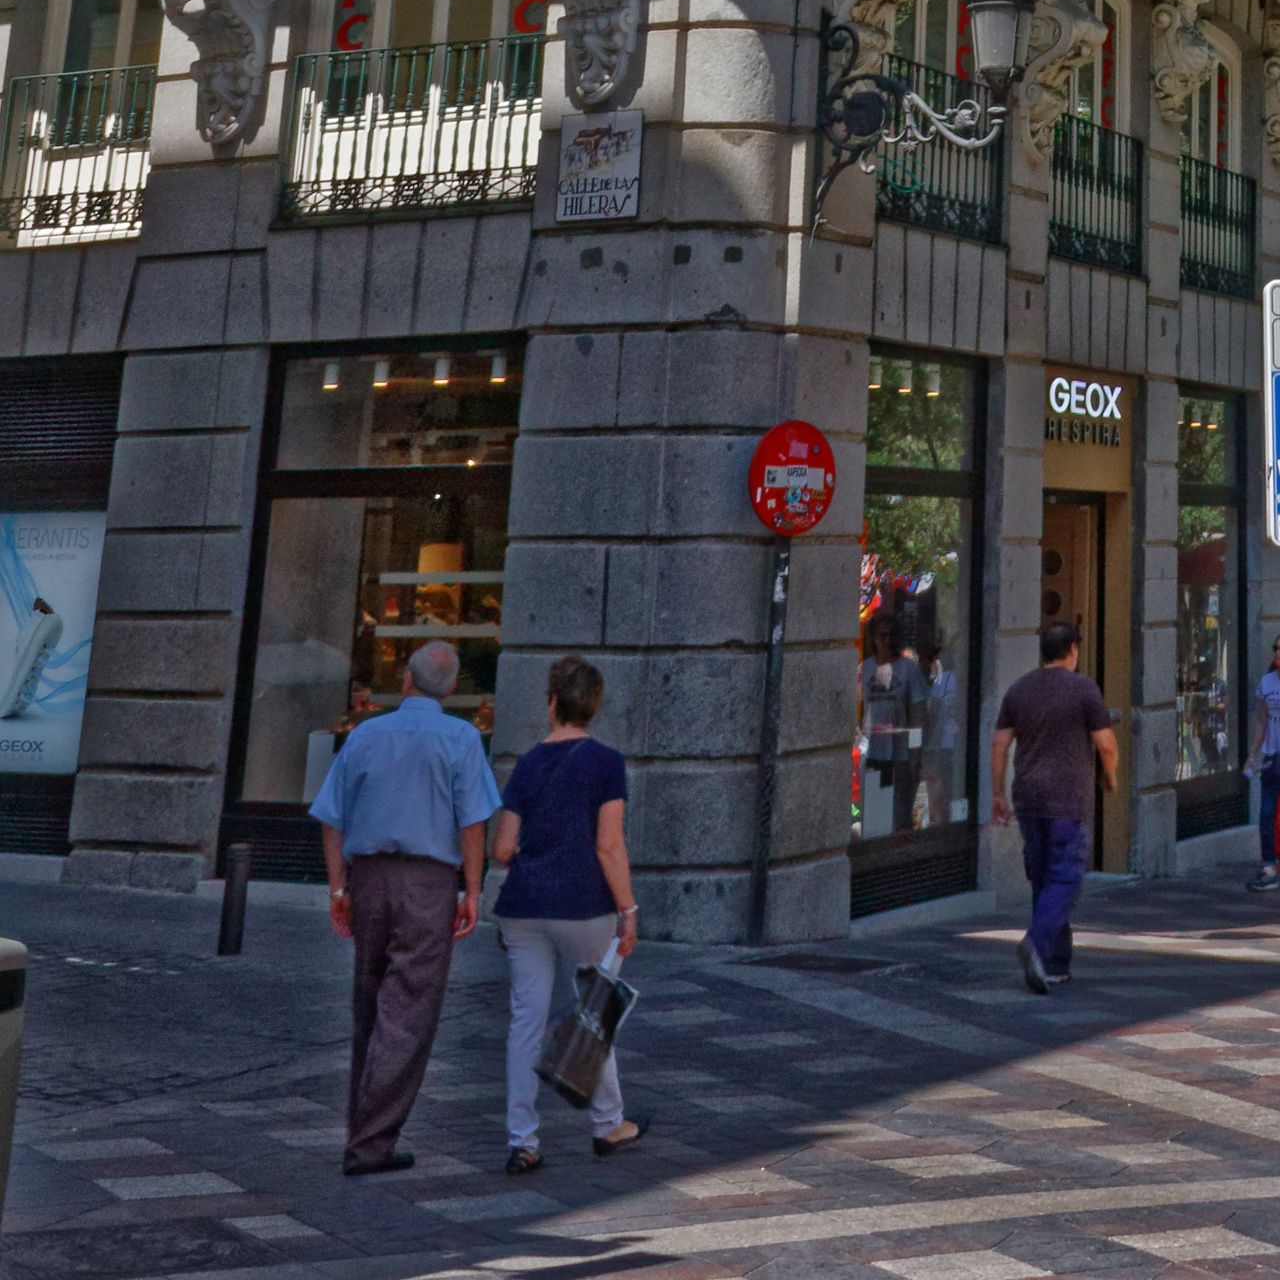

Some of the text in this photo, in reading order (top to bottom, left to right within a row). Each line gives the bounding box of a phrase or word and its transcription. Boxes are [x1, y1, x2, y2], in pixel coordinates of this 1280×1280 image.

[559, 177, 640, 195] CALLE DE LAS
[563, 193, 632, 217] HILERAS
[1049, 377, 1122, 419] GEOX
[1047, 417, 1121, 447] RESPIRA
[0, 739, 44, 753] GEOX
